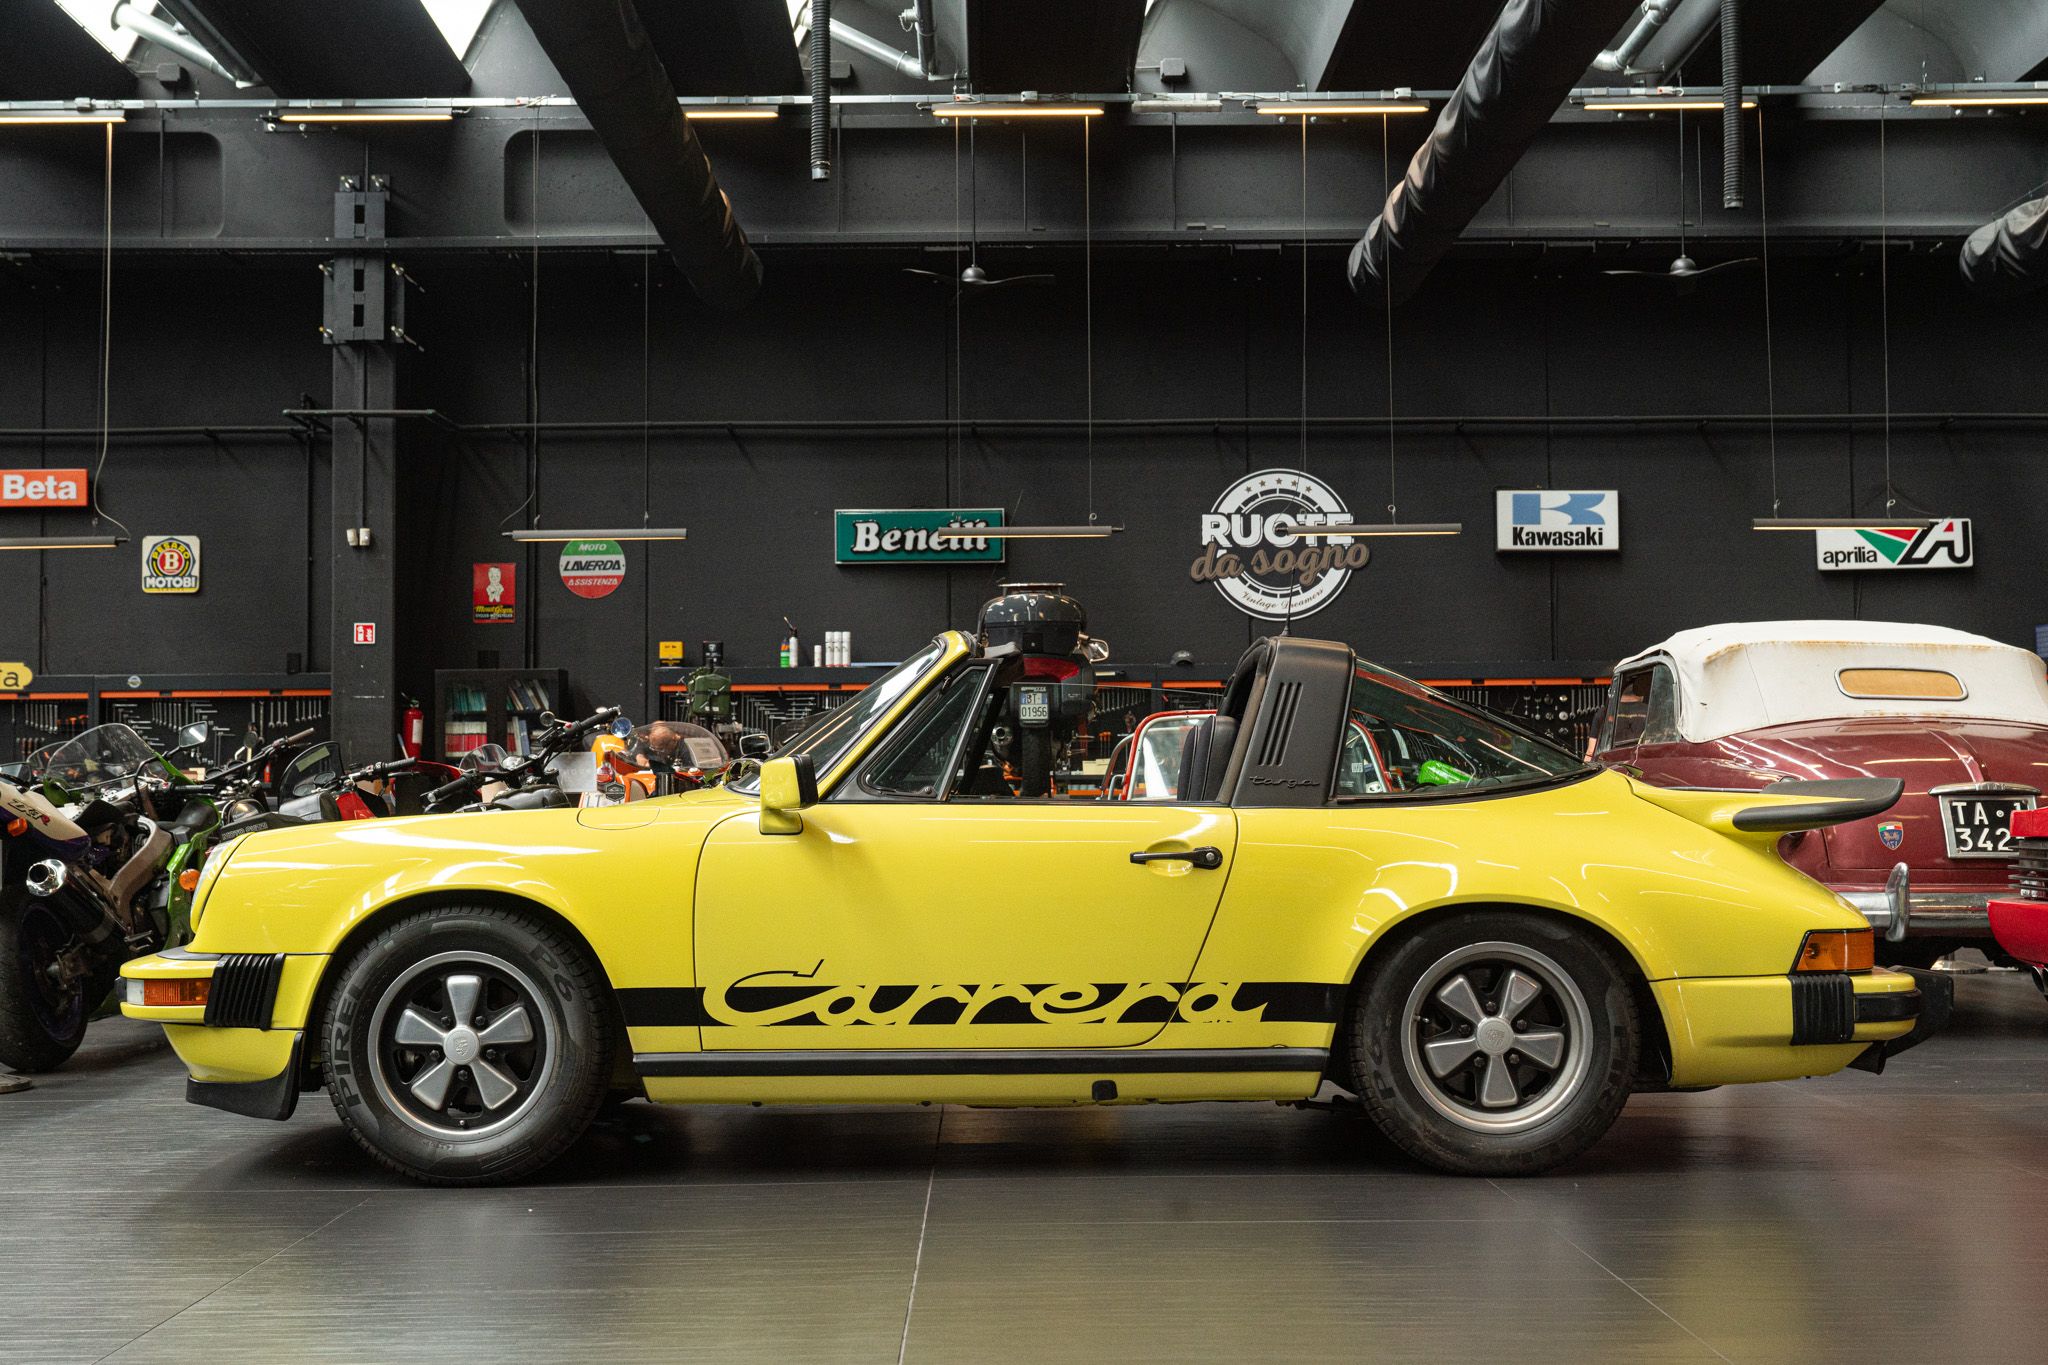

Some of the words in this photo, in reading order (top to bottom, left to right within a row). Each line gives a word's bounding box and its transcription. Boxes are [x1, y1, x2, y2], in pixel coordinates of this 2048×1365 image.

[3, 474, 77, 500] Beta
[852, 521, 988, 552] Benelli
[1201, 513, 1355, 548] RUOTE
[1512, 526, 1603, 546] Kawasaki
[152, 542, 190, 559] PESARO
[579, 543, 607, 551] MOTO
[1823, 546, 1878, 567] aprilia
[163, 551, 180, 570] B
[563, 560, 621, 571] LAVERDA
[1190, 543, 1244, 582] da
[1251, 543, 1369, 586] sogno
[146, 576, 196, 588] MOTOBI
[568, 578, 618, 586] ASSISTENZA
[1241, 591, 1277, 610] Vintage
[1021, 706, 1047, 718] 01956
[1951, 801, 1989, 825] TA
[1955, 827, 2020, 851] 342
[528, 943, 576, 1002] P6
[702, 959, 1268, 1026] Carrera
